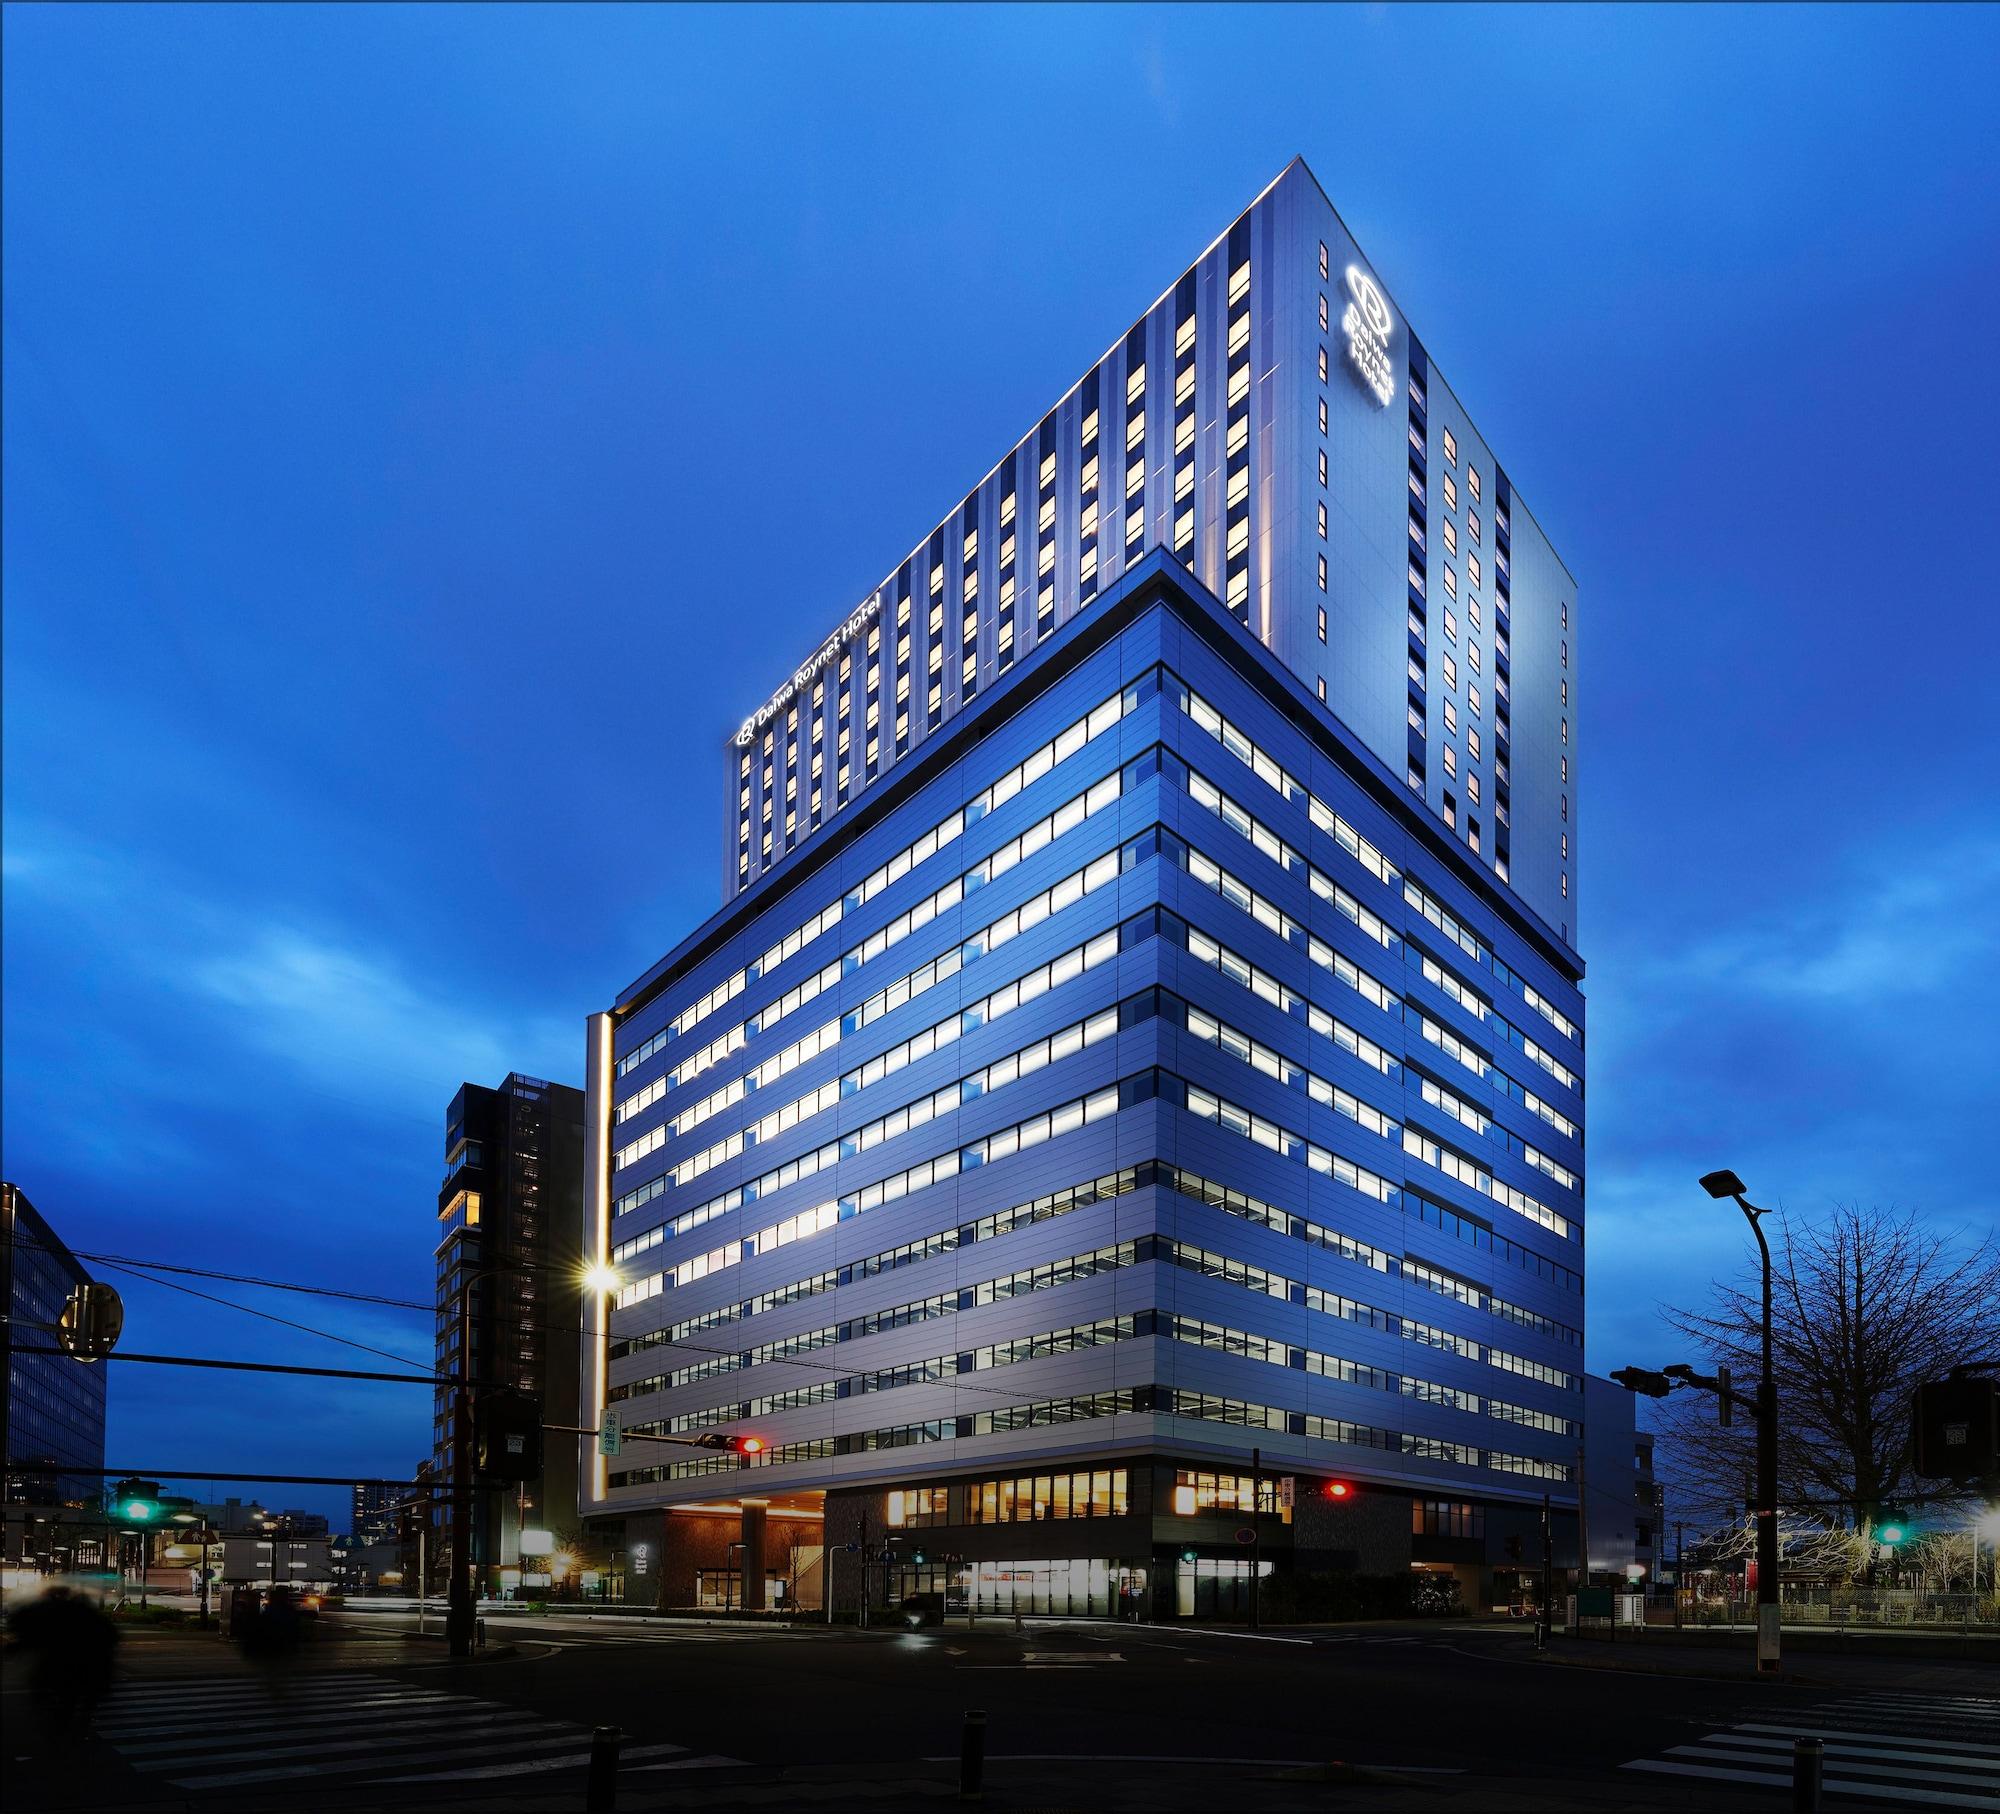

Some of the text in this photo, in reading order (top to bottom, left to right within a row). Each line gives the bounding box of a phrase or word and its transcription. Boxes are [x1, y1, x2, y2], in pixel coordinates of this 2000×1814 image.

[758, 592, 881, 727] Daiwa Roynet Hotel
